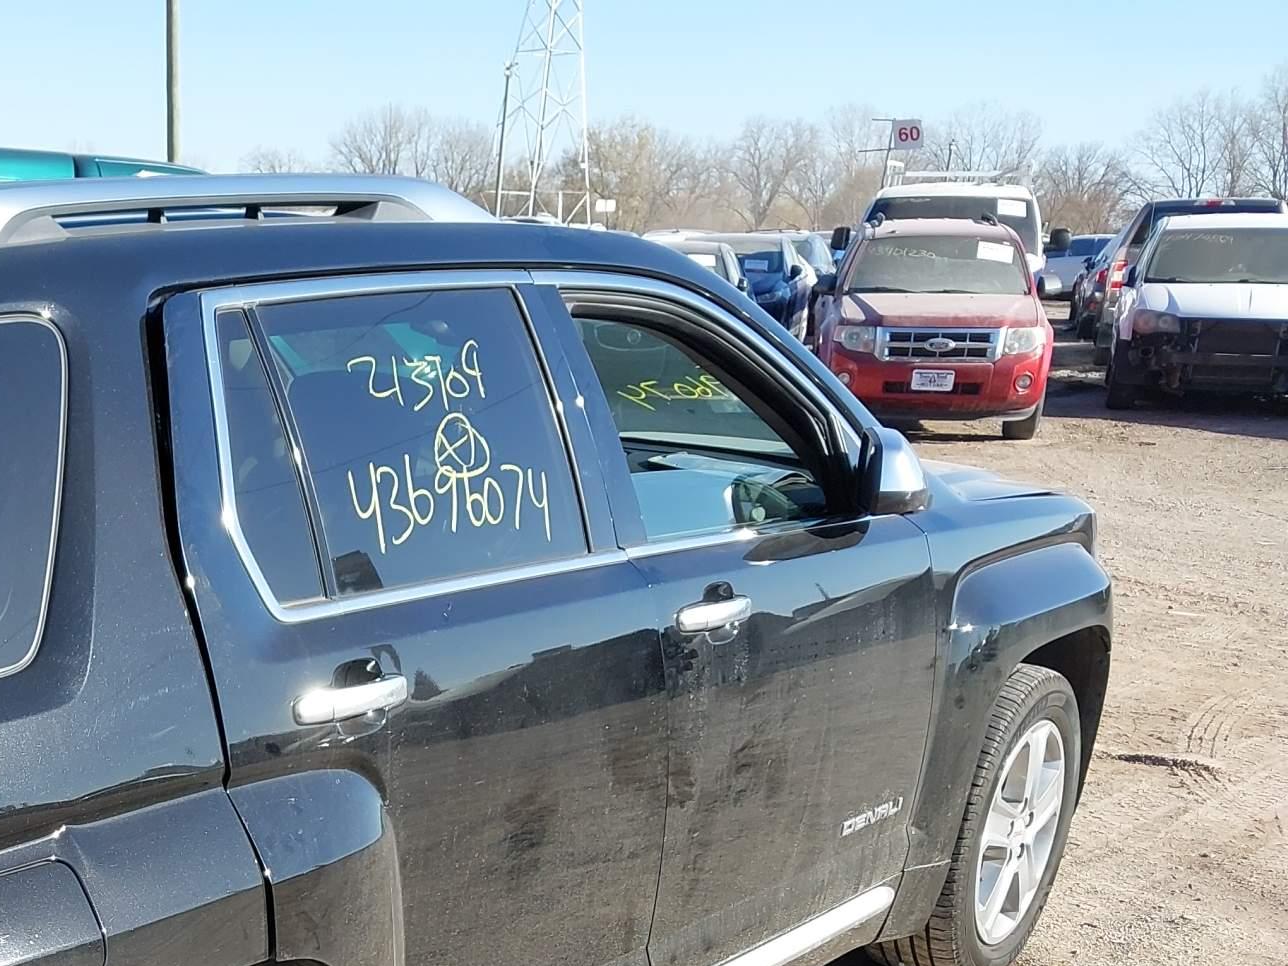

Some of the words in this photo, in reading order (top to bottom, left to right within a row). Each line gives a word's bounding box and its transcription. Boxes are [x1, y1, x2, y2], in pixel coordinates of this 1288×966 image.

[898, 126, 920, 142] 60
[347, 453, 551, 554] 43696074
[840, 796, 904, 838] DENALI
